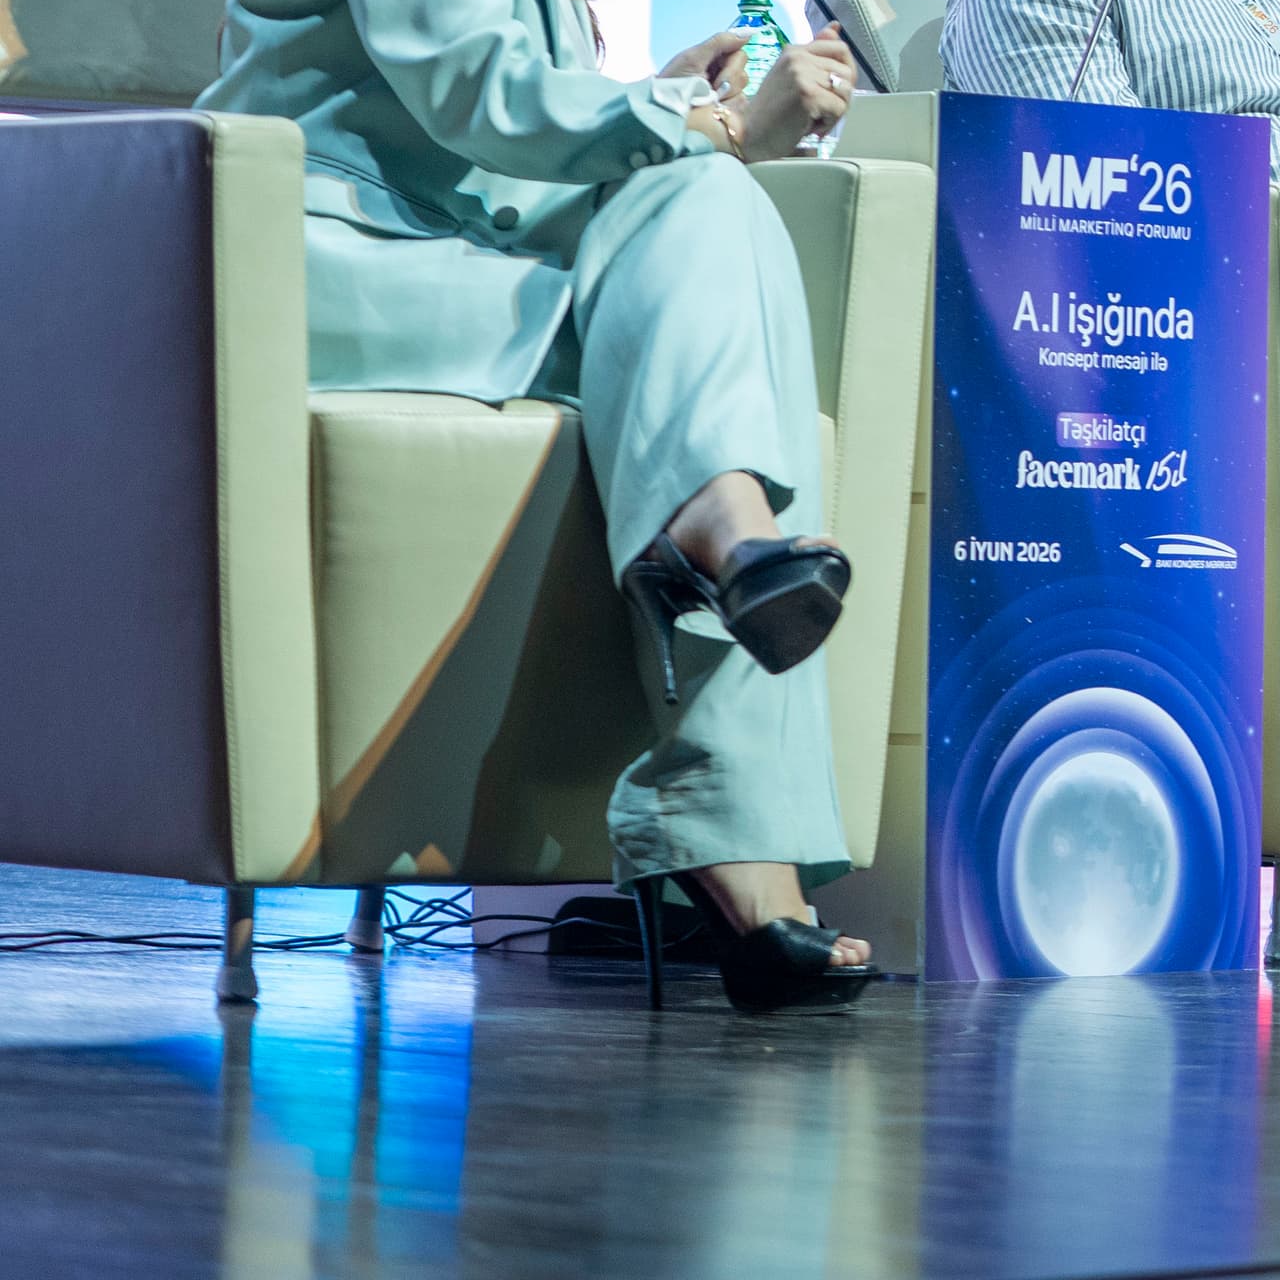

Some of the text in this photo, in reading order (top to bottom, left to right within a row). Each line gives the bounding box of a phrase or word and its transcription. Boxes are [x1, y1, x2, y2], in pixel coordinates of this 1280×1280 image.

[1020, 212, 1191, 240] MİLLİ MARKETİNQ FORUMU
[1013, 291, 1194, 347] A.I işığında
[1039, 347, 1168, 374] Konsept mesajı ilə
[1059, 418, 1146, 448] Təşkilatçı
[1016, 450, 1142, 490] facemark
[954, 536, 1061, 562] 6 İYUN 2026
